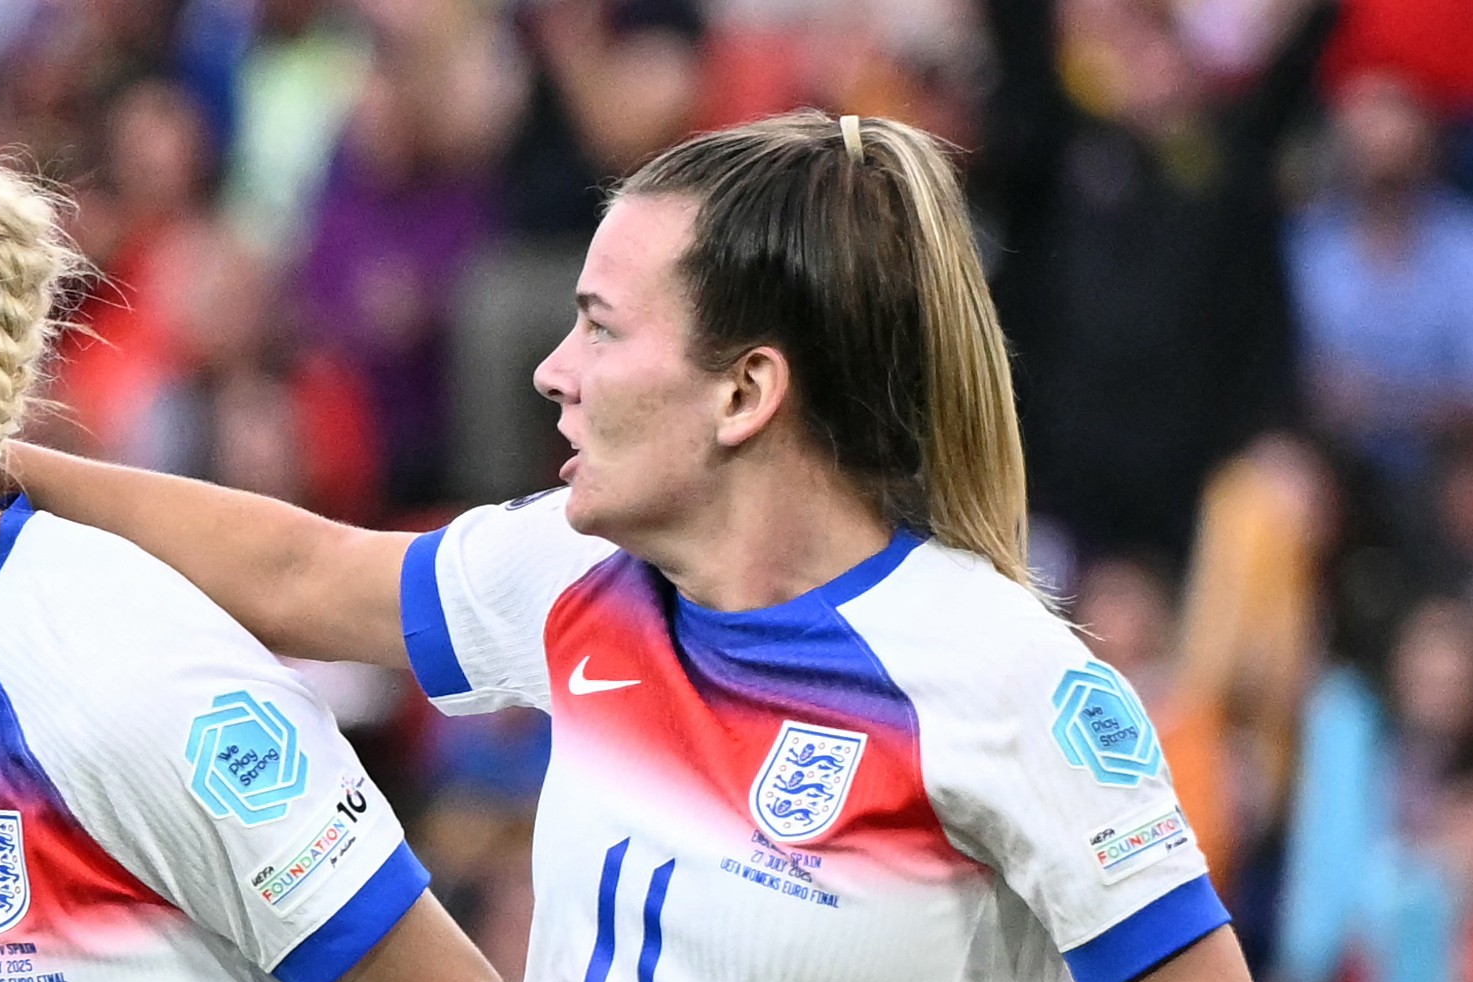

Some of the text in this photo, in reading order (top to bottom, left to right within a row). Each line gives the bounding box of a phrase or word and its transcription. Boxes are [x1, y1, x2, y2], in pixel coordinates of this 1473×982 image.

[1082, 706, 1103, 718] We
[1091, 717, 1120, 732] Play
[1099, 726, 1138, 747] Strong
[217, 745, 239, 761] We
[229, 749, 258, 776] Play
[239, 748, 280, 787] Strong
[262, 818, 346, 902] FOUNDATION
[764, 855, 788, 872] JULY
[251, 865, 275, 887] UEFA
[720, 856, 840, 908] UEFA WOMENS EURO FINAL
[6, 943, 37, 955] SPAIN
[6, 959, 33, 973] 2025
